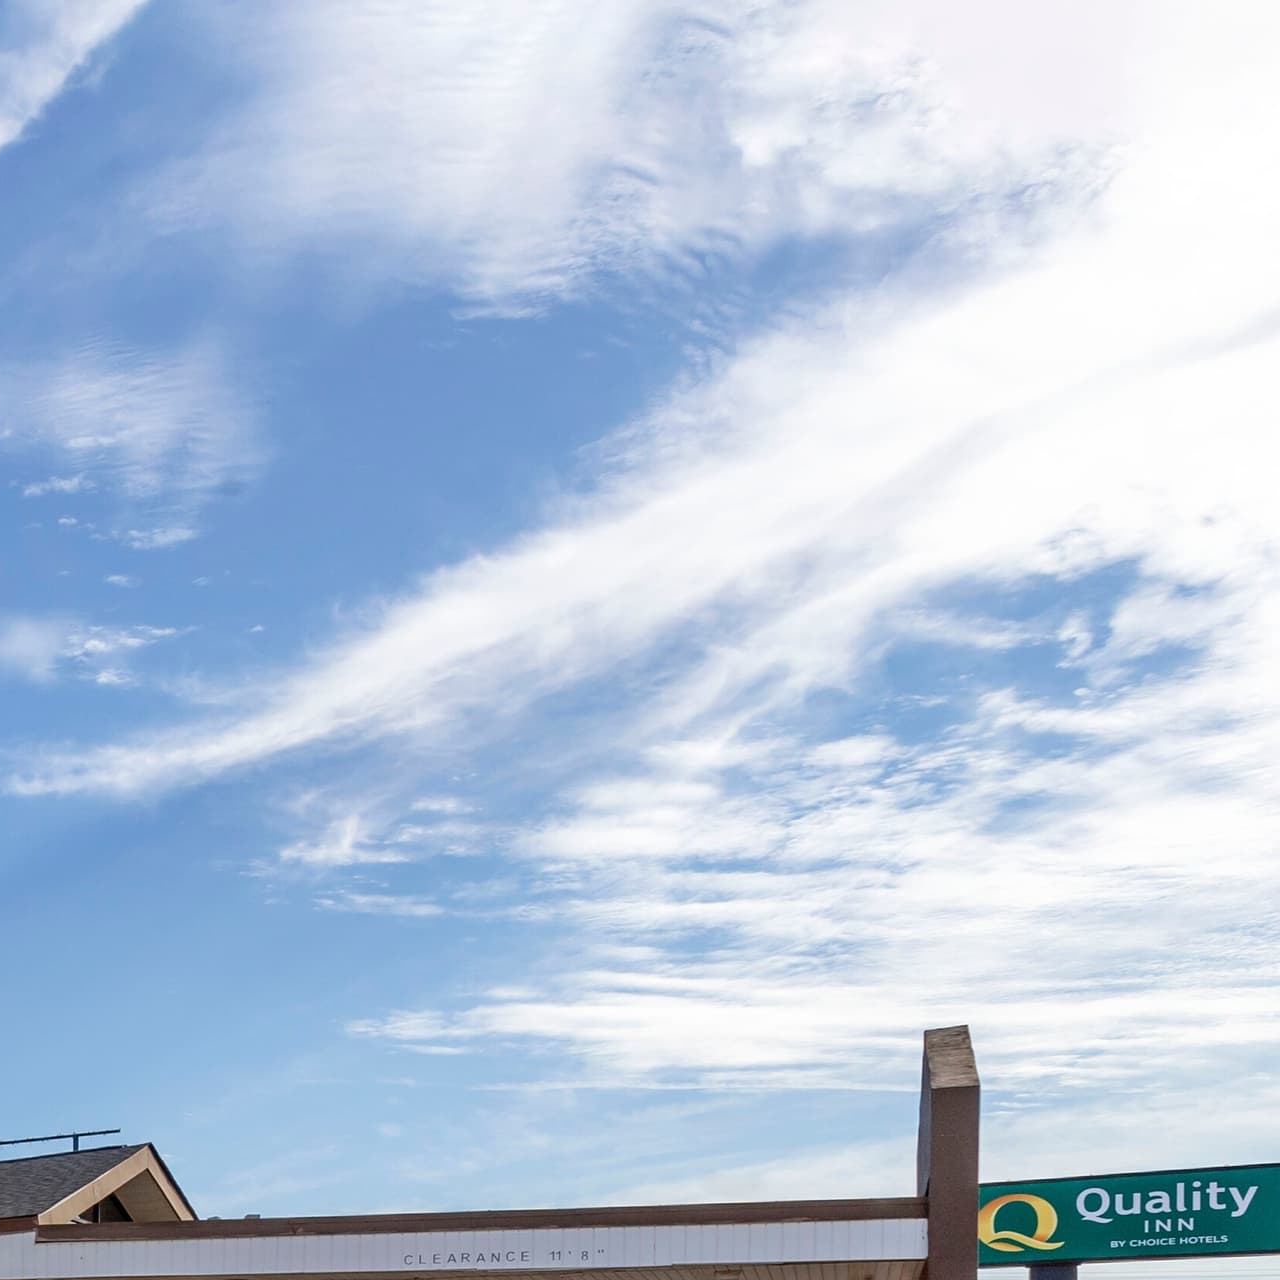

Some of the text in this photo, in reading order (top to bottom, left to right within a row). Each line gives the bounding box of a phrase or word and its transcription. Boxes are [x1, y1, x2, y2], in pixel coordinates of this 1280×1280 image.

[1076, 1181, 1258, 1224] Quality
[978, 1193, 1065, 1252] Q
[1143, 1217, 1195, 1233] INN
[1110, 1235, 1229, 1248] BY CHOICE HOTELS
[403, 1251, 530, 1265] CLEARANCE
